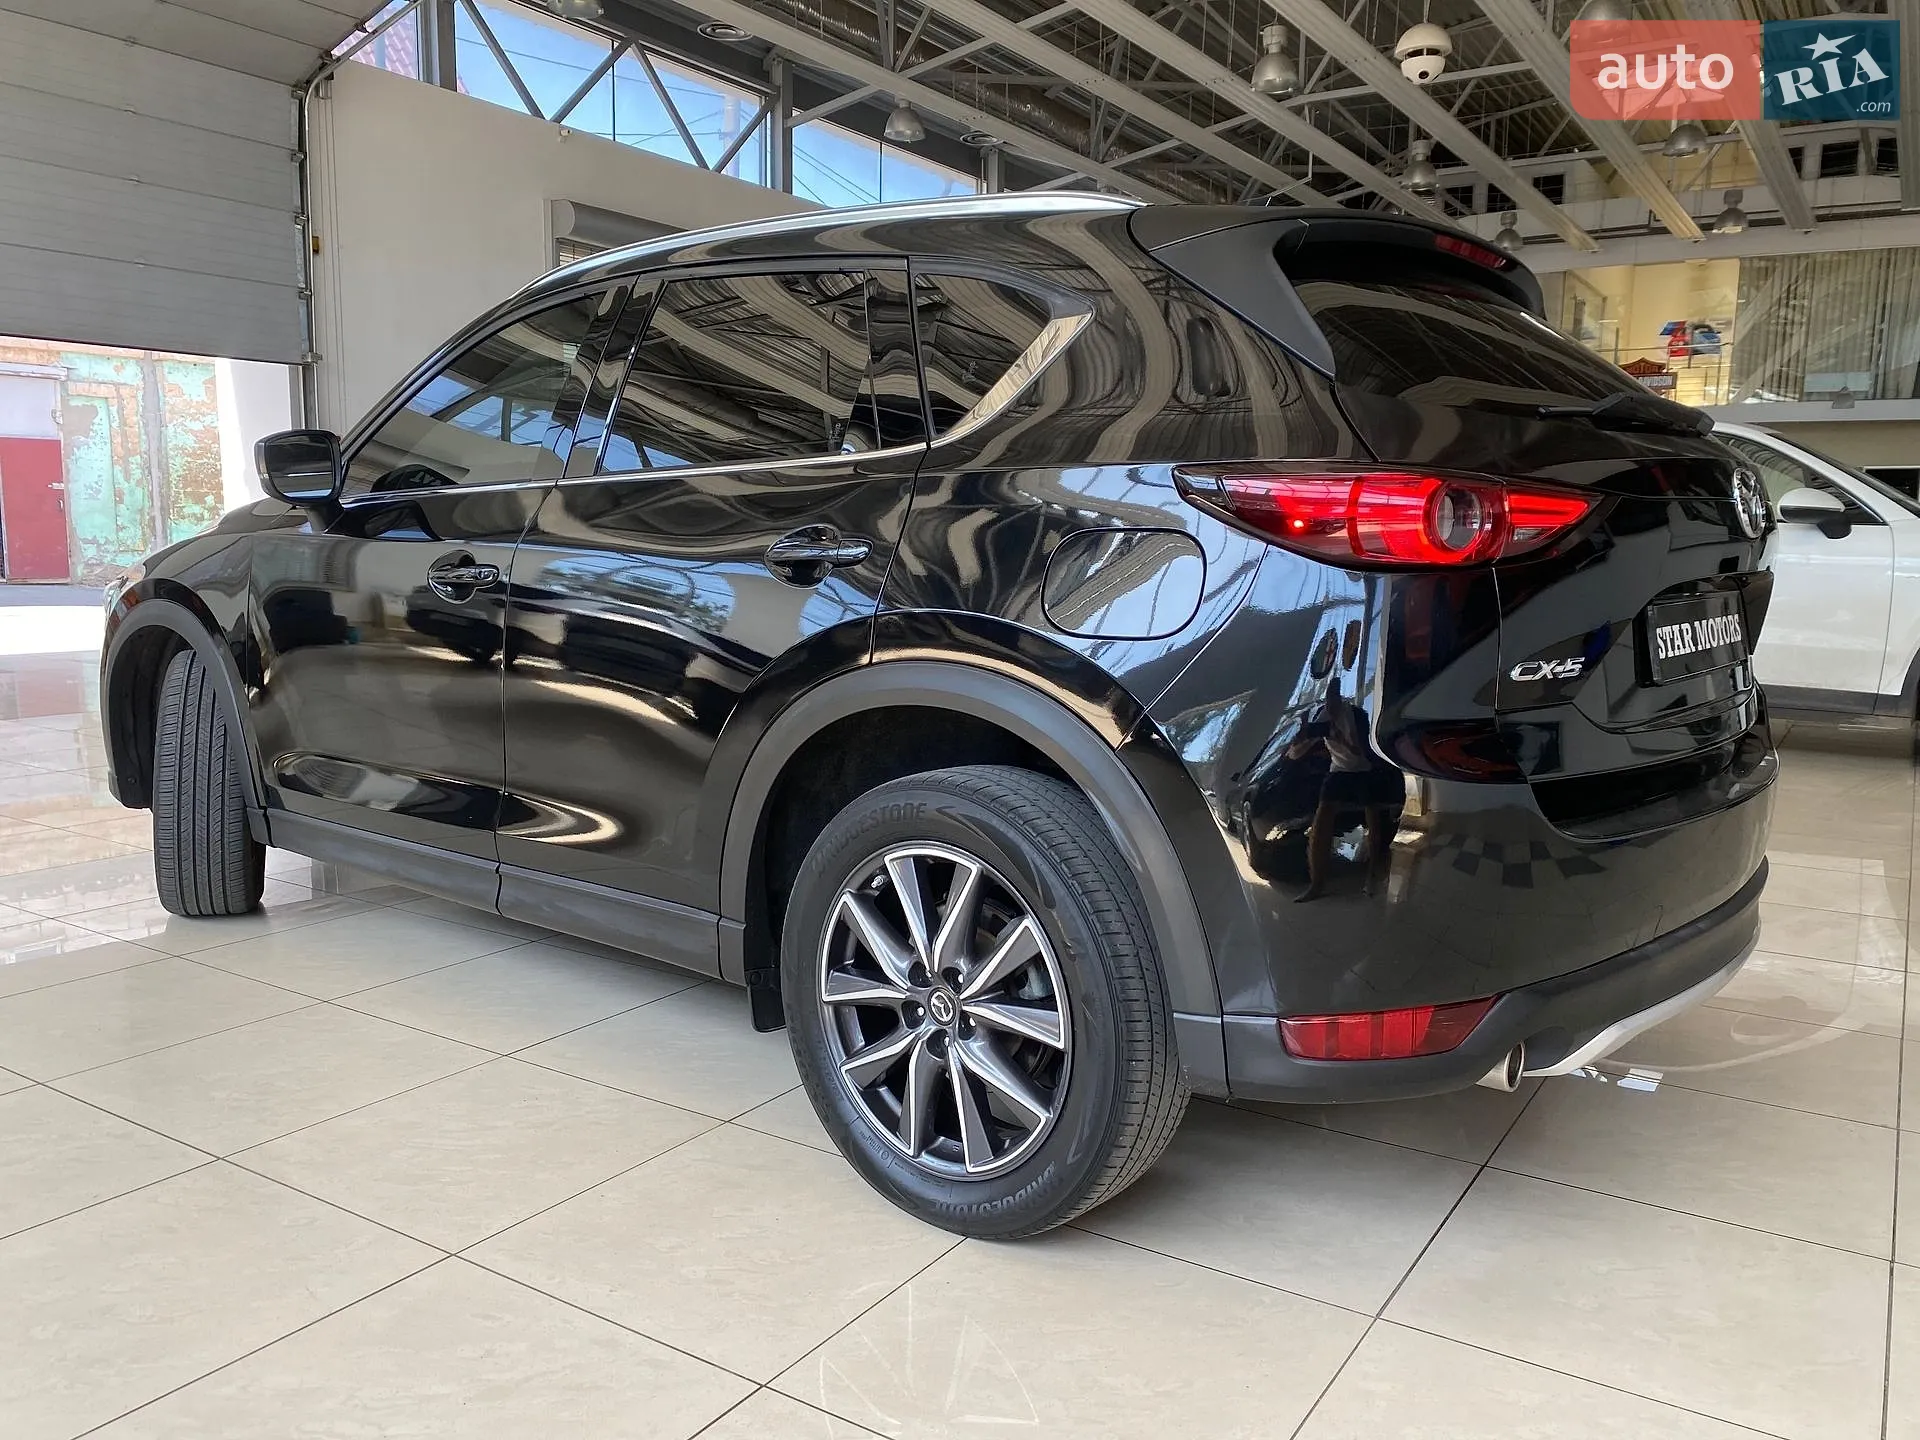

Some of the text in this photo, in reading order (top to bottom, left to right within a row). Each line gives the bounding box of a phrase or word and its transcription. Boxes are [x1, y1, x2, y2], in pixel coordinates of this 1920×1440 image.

[1656, 614, 1742, 660] STAR MOTORS
[1510, 656, 1585, 682] CX-5
